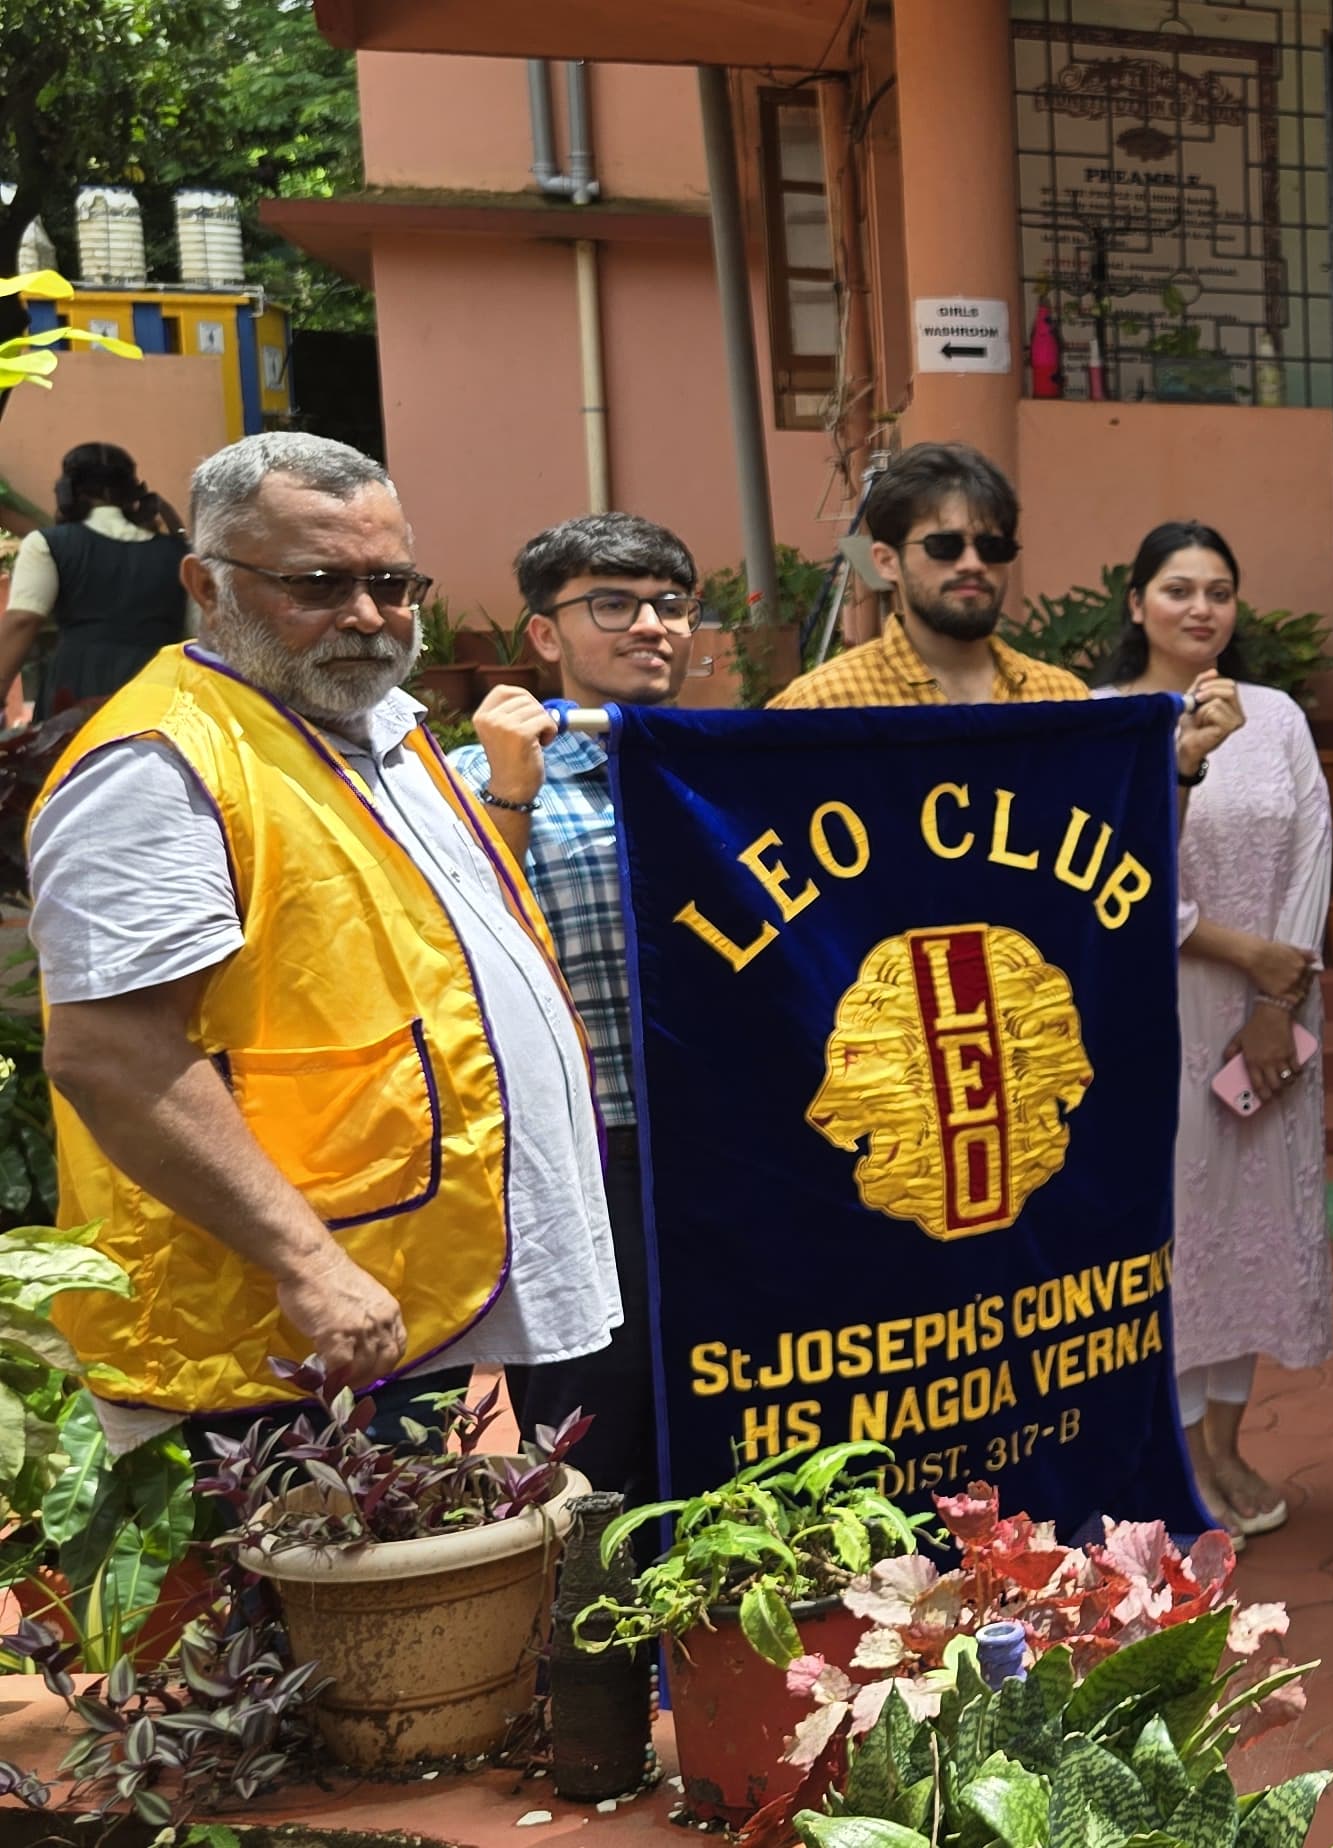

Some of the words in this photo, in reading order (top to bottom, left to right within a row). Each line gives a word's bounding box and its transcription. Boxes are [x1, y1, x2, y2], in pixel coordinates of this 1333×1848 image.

[1084, 168, 1200, 186] PREAMBE
[924, 327, 999, 338] WASHROOM
[938, 307, 979, 317] GIRLS
[672, 800, 870, 973] LEO
[921, 782, 1152, 930] CLUB
[922, 938, 1002, 1221] LEO
[742, 1400, 821, 1462] HS
[850, 1360, 1018, 1443] NAGOA
[1031, 1311, 1164, 1397] VERNA
[876, 1445, 971, 1499] DIST.
[985, 1408, 1082, 1472] 317-B
